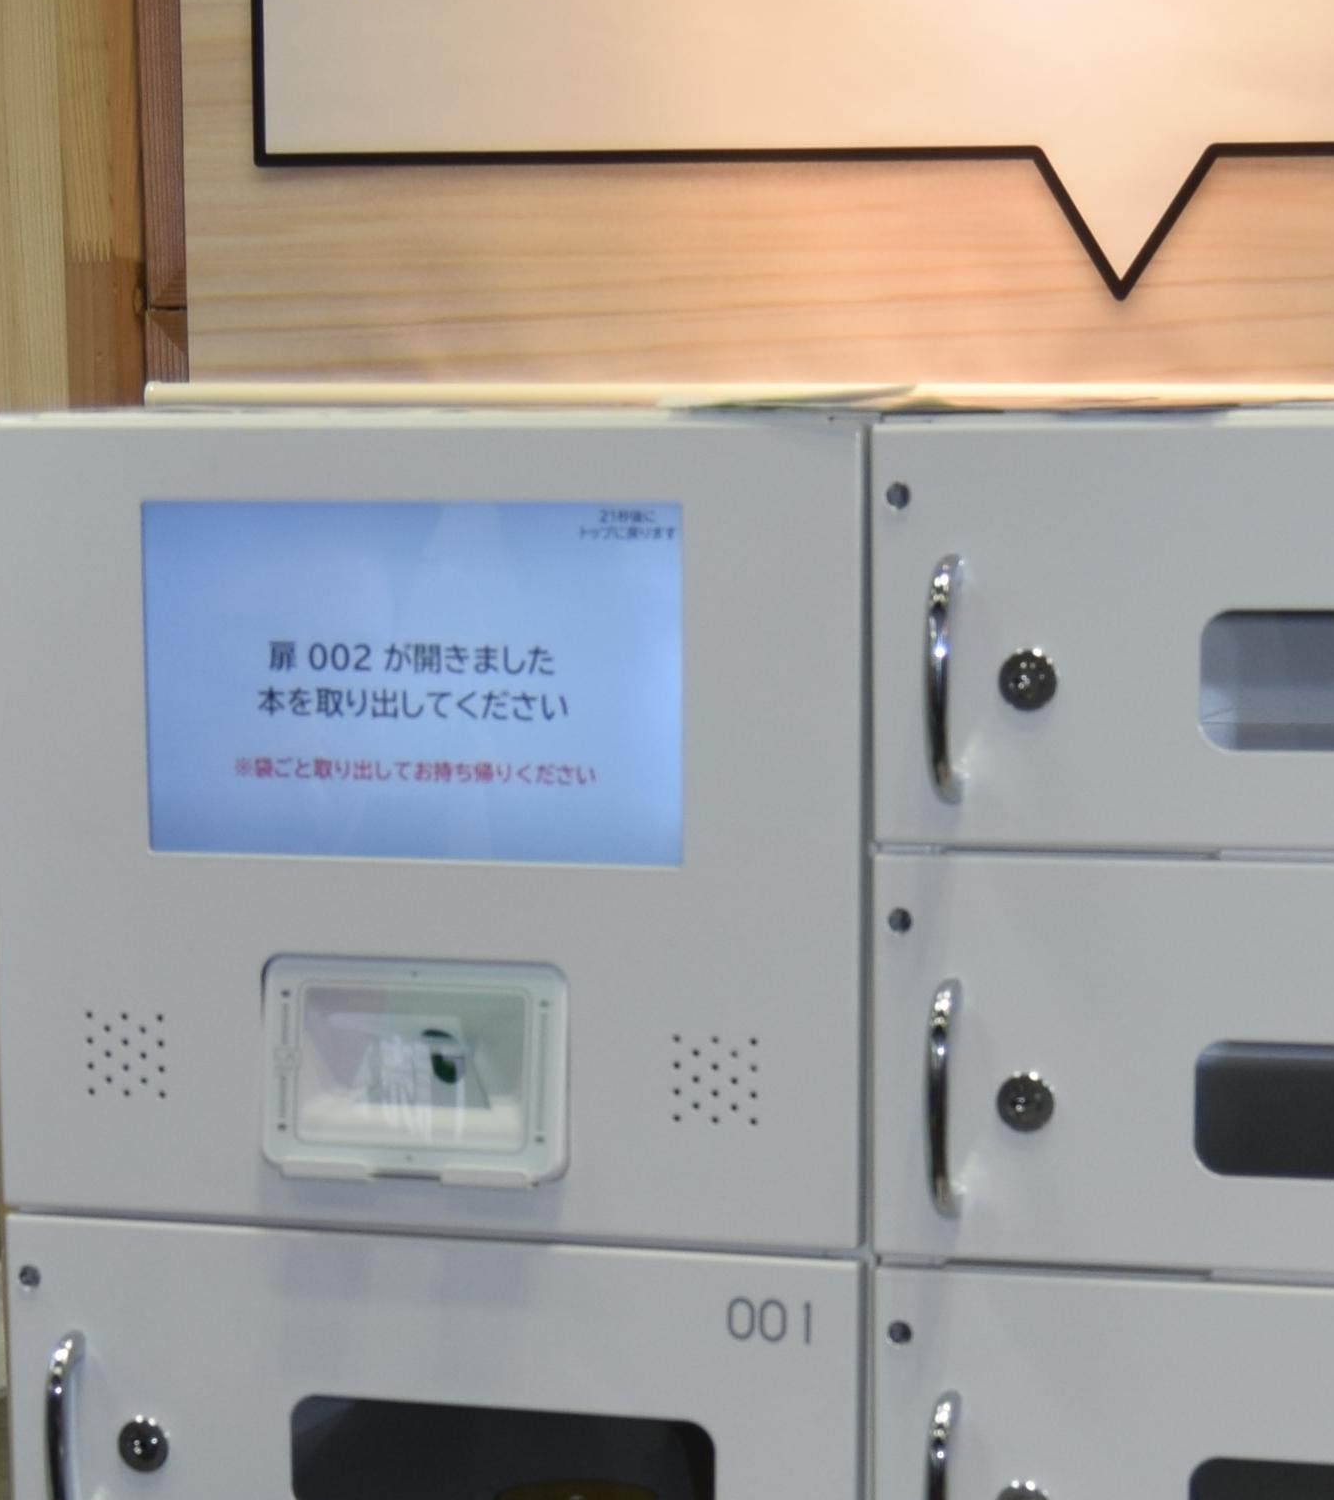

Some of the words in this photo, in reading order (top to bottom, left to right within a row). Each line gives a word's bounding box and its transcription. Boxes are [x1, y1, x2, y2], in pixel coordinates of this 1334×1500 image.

[267, 641, 297, 672] 扉
[308, 643, 373, 672] 002
[383, 642, 556, 677] が開きました
[257, 687, 569, 722] 本を取り出してください
[726, 1295, 813, 1346] 001
